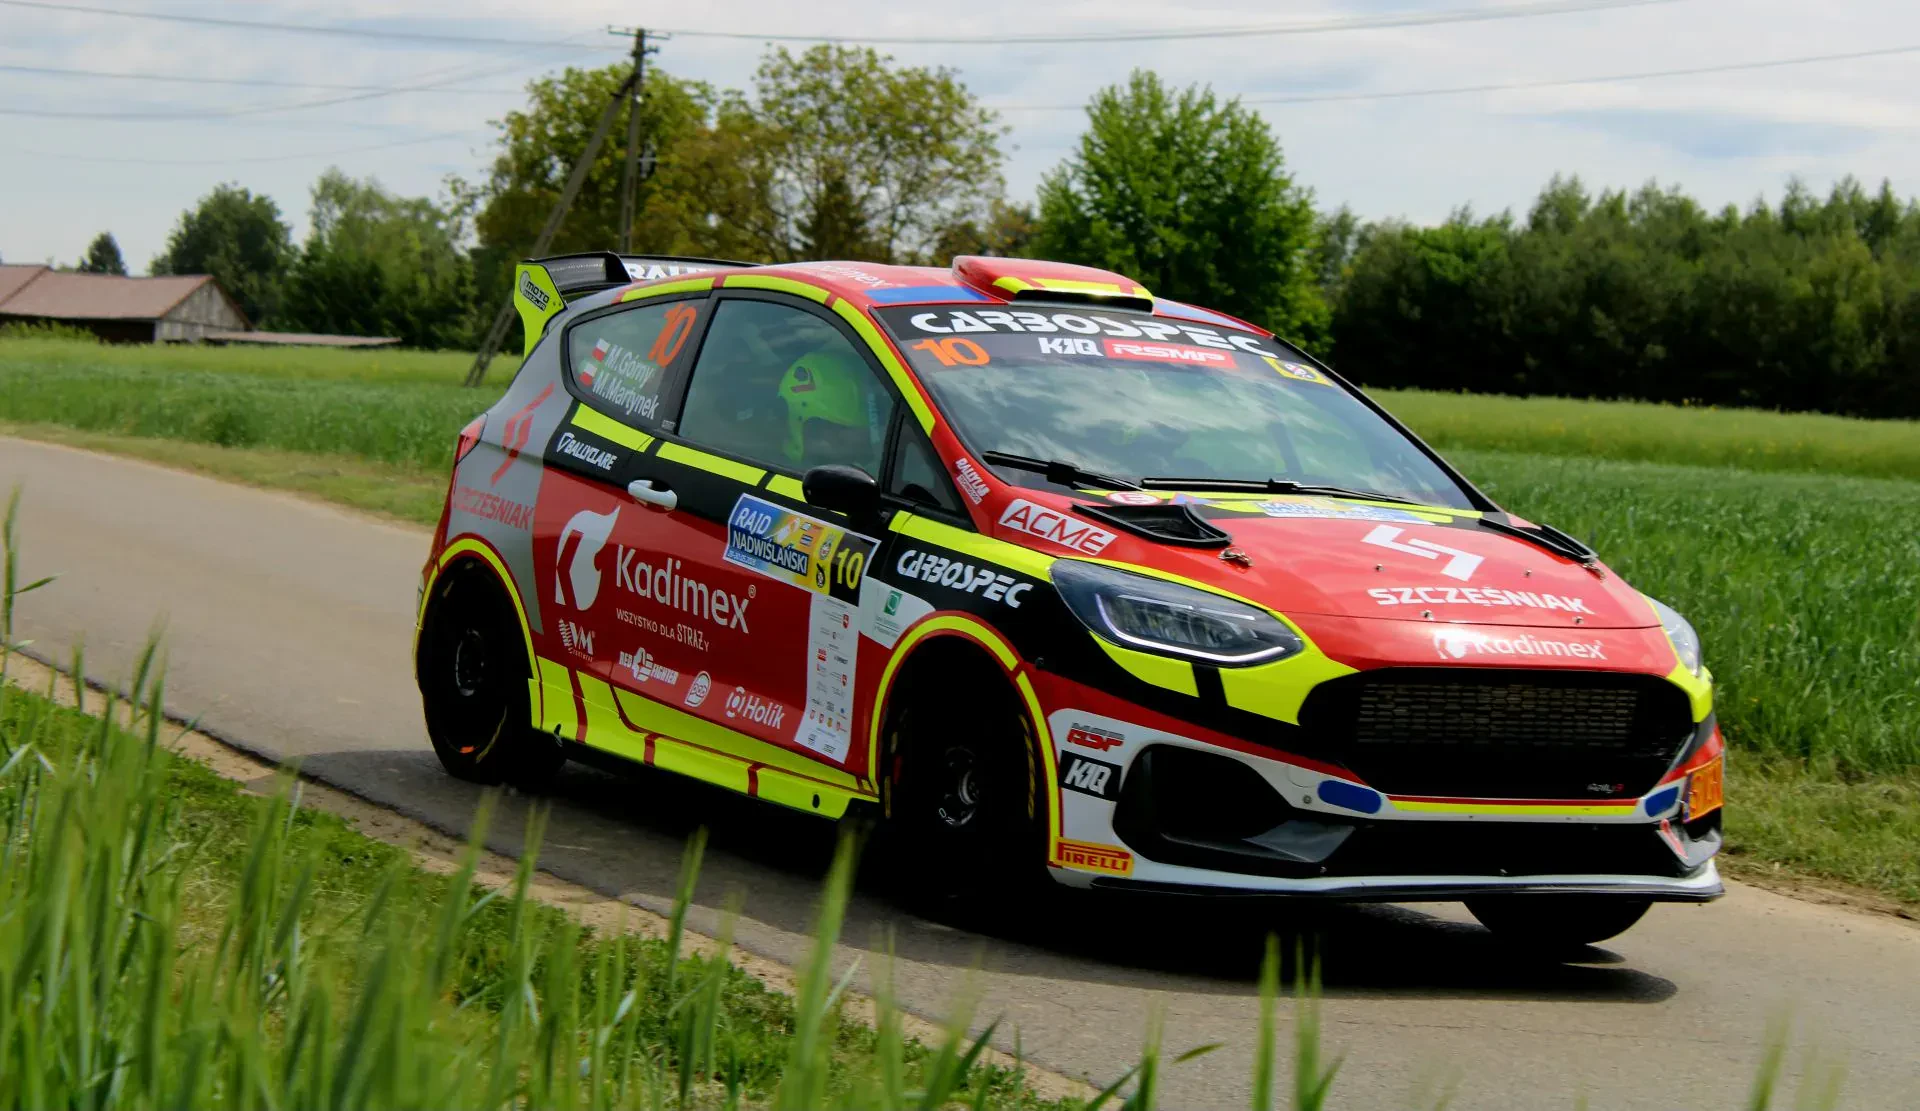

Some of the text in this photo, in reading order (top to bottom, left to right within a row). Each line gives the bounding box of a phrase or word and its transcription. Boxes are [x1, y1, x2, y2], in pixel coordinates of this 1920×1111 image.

[648, 303, 697, 368] 10
[911, 310, 1279, 358] CARBOSPEC
[911, 337, 991, 367] 10
[1111, 343, 1226, 362] RSMP
[592, 370, 660, 420] M.Martynek
[735, 507, 772, 535] RAJD
[1003, 505, 1106, 554] ACME
[732, 530, 808, 574] NADWIŚLAŃSKI
[837, 547, 864, 590] 10
[897, 549, 1034, 609] CARBOSPEC
[615, 608, 710, 652] WSZYSTKO DLA STRAŻY
[1057, 841, 1132, 873] PIRELLI
